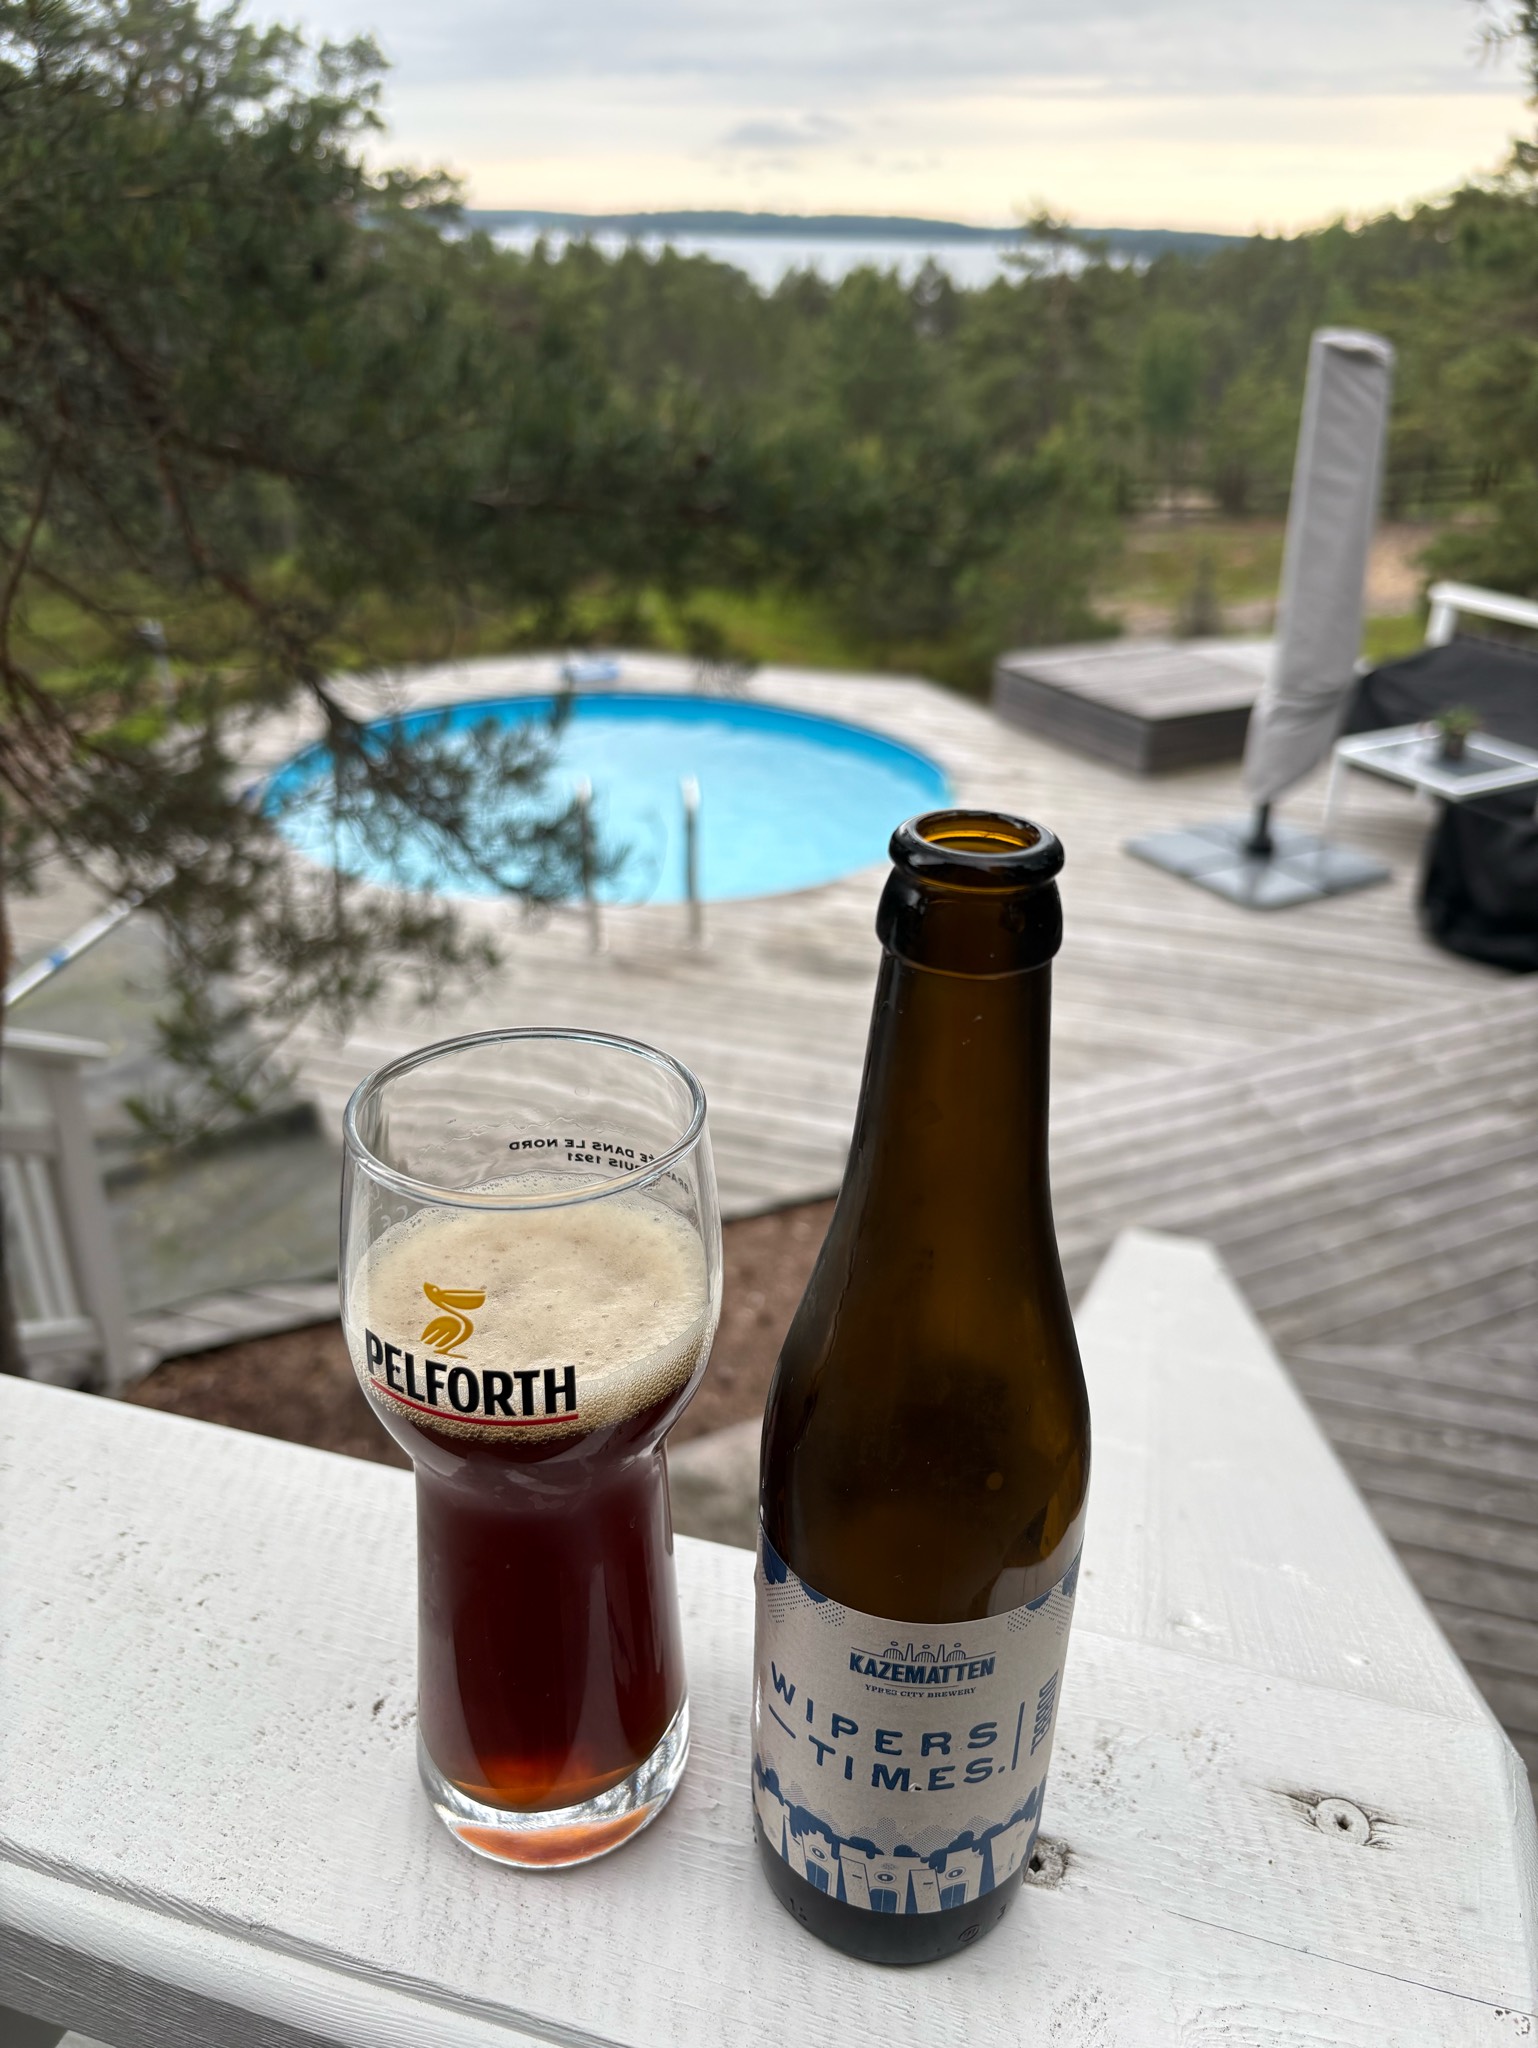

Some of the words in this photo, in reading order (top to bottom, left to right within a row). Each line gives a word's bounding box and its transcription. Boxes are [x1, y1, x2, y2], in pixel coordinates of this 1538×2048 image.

[365, 1328, 577, 1416] PELFORTH
[849, 1651, 995, 1684] KAZEMATTEN
[900, 1689, 924, 1698] CITY
[927, 1687, 977, 1698] BREWERY
[771, 1661, 997, 1757] WIPERS
